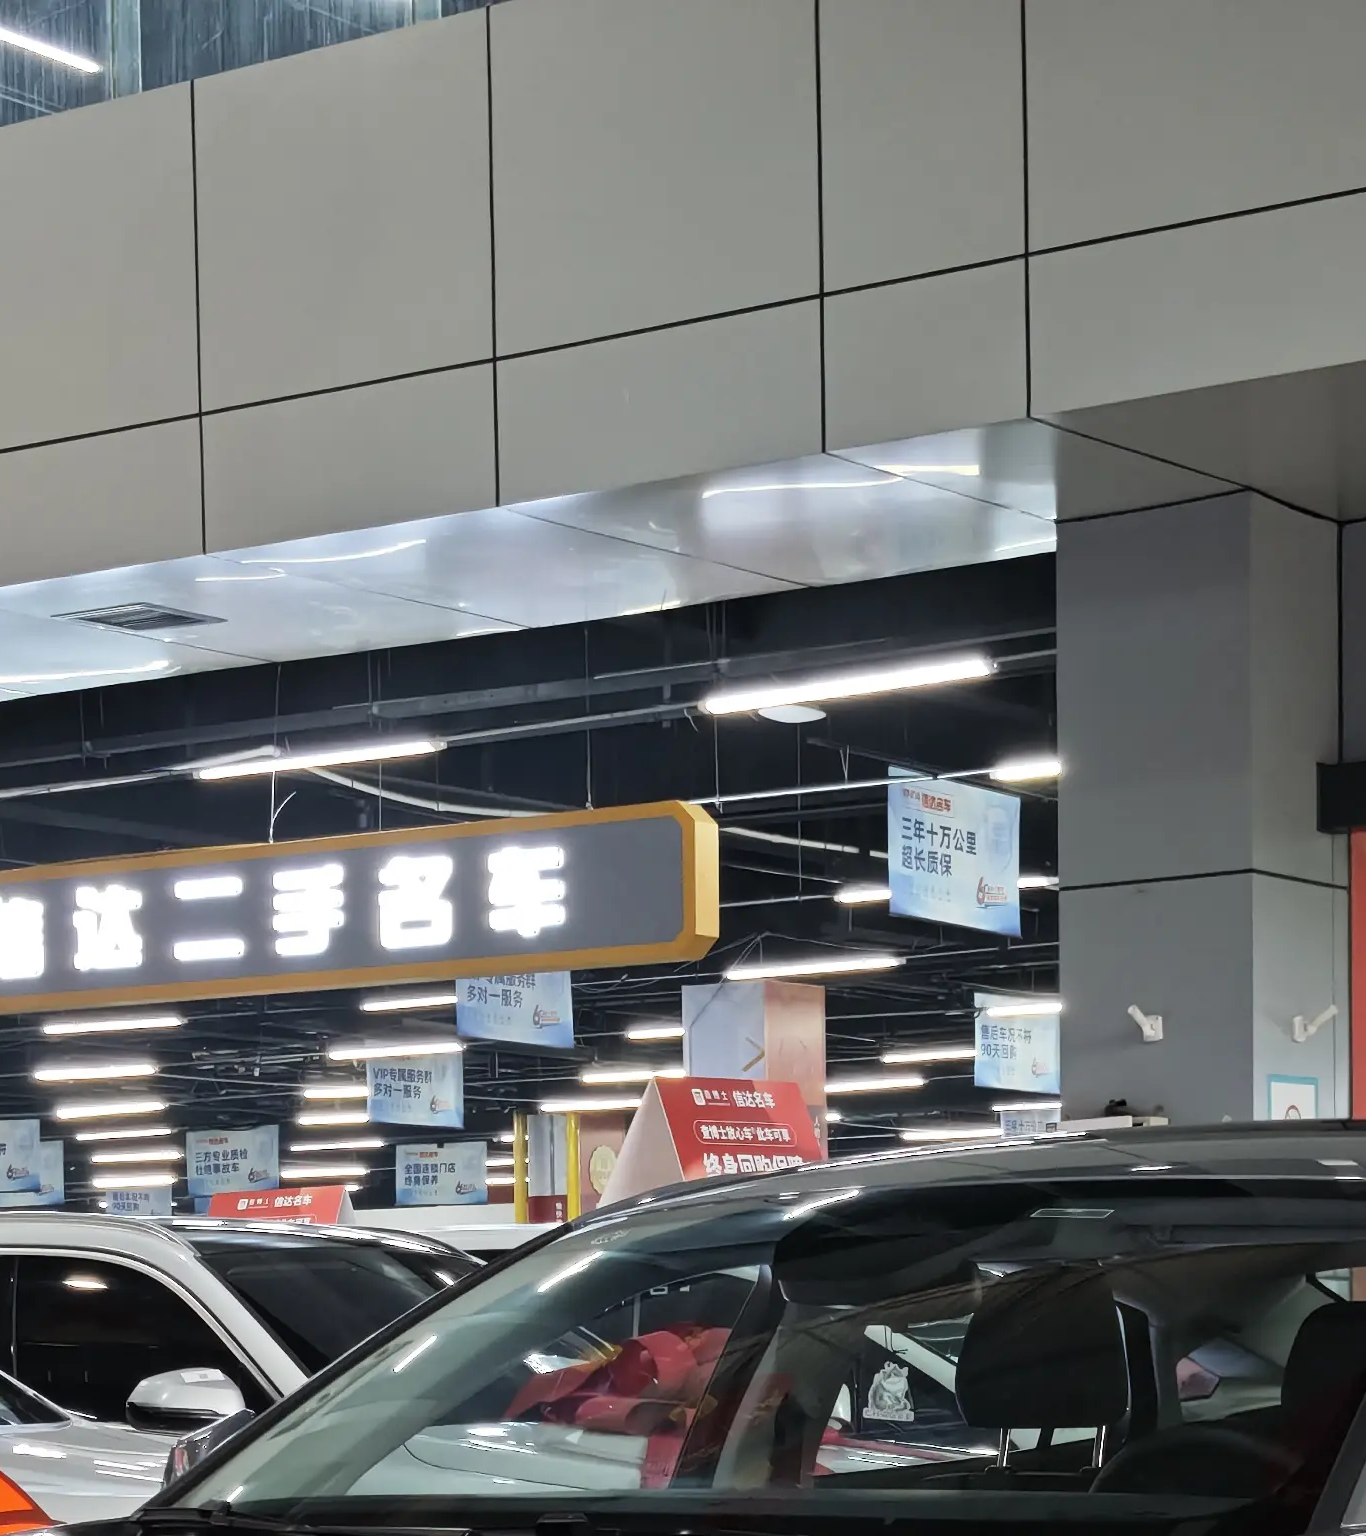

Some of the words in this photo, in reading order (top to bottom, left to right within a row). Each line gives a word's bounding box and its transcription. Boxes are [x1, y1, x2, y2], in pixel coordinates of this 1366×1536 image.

[901, 816, 978, 856] 三年十万公里
[901, 844, 953, 877] 超长质保
[467, 984, 524, 1008] 多对一服务
[980, 1042, 1018, 1060] 90天回购
[733, 1090, 776, 1109] 信达名车
